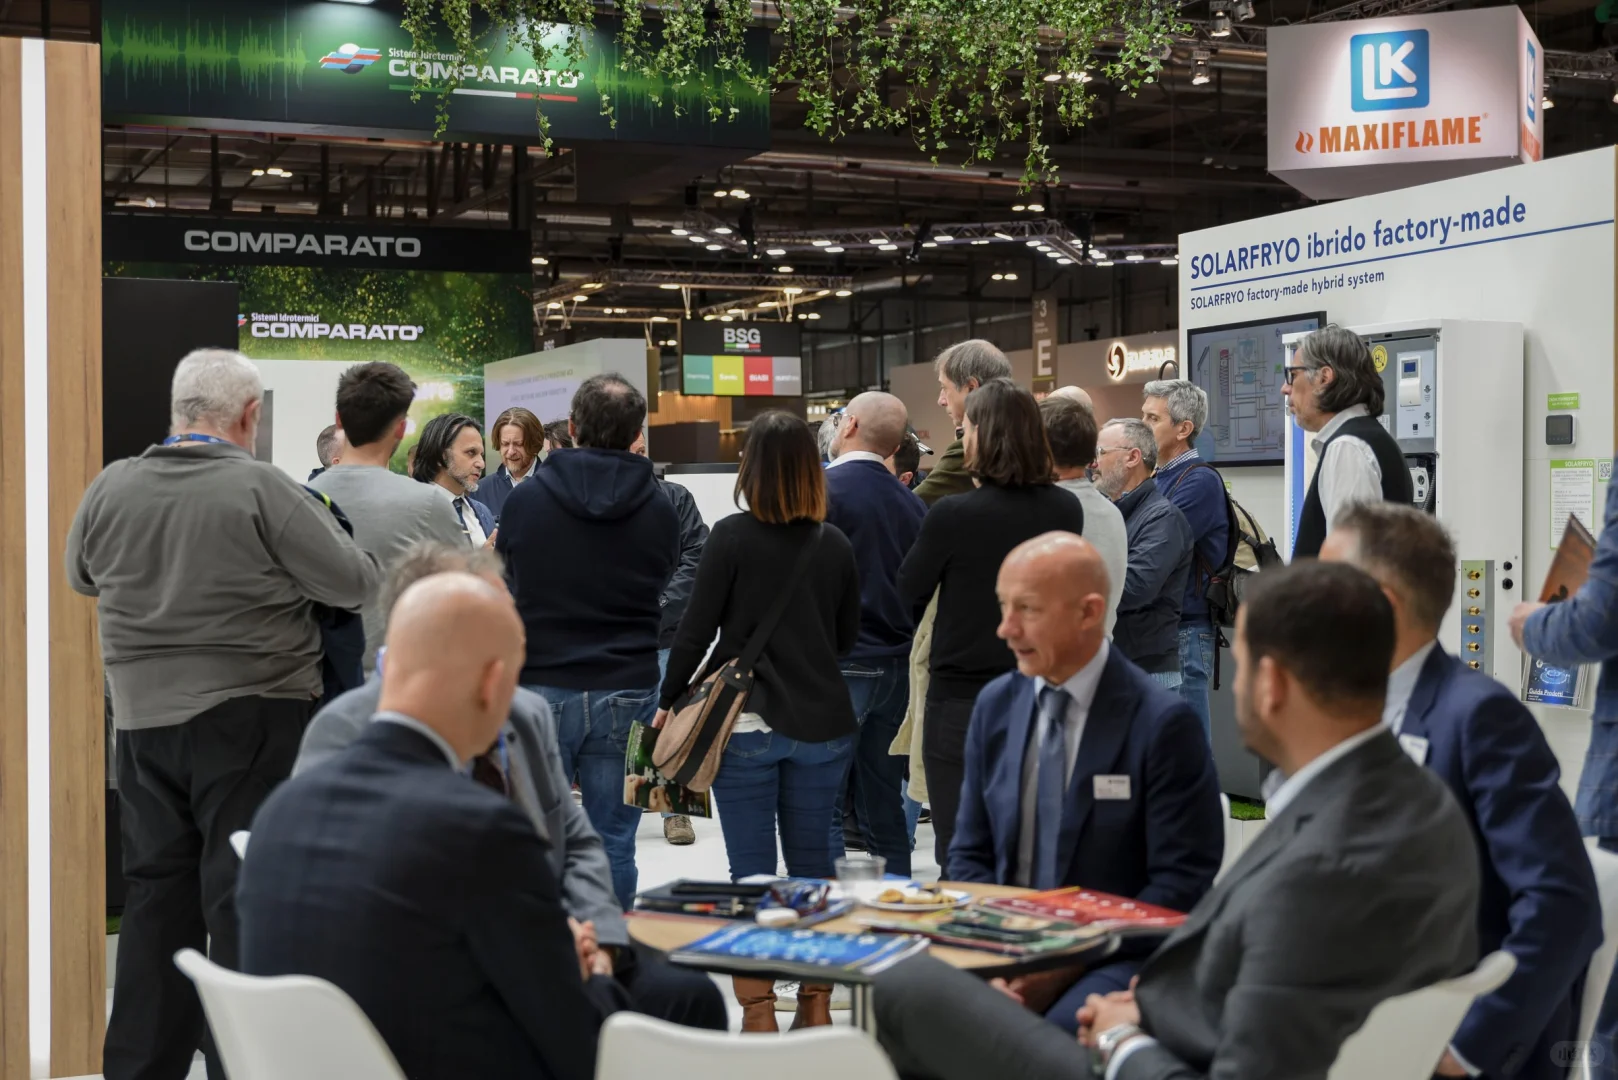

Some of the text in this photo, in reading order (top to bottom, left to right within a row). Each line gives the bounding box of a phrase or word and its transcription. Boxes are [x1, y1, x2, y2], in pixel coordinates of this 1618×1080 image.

[388, 47, 419, 59] Sistem
[1362, 41, 1417, 100] LK
[184, 230, 422, 258] COMPARATO
[1191, 195, 1526, 279] SOLARFRYO ibrido factory-made
[1190, 269, 1385, 310] SOLARFRYO factory-made hybrid system
[251, 312, 320, 322] Sistemi Idrotermici
[723, 328, 761, 344] BSG
[1037, 339, 1052, 376] E
[1564, 460, 1594, 468] SOLARFRYO
